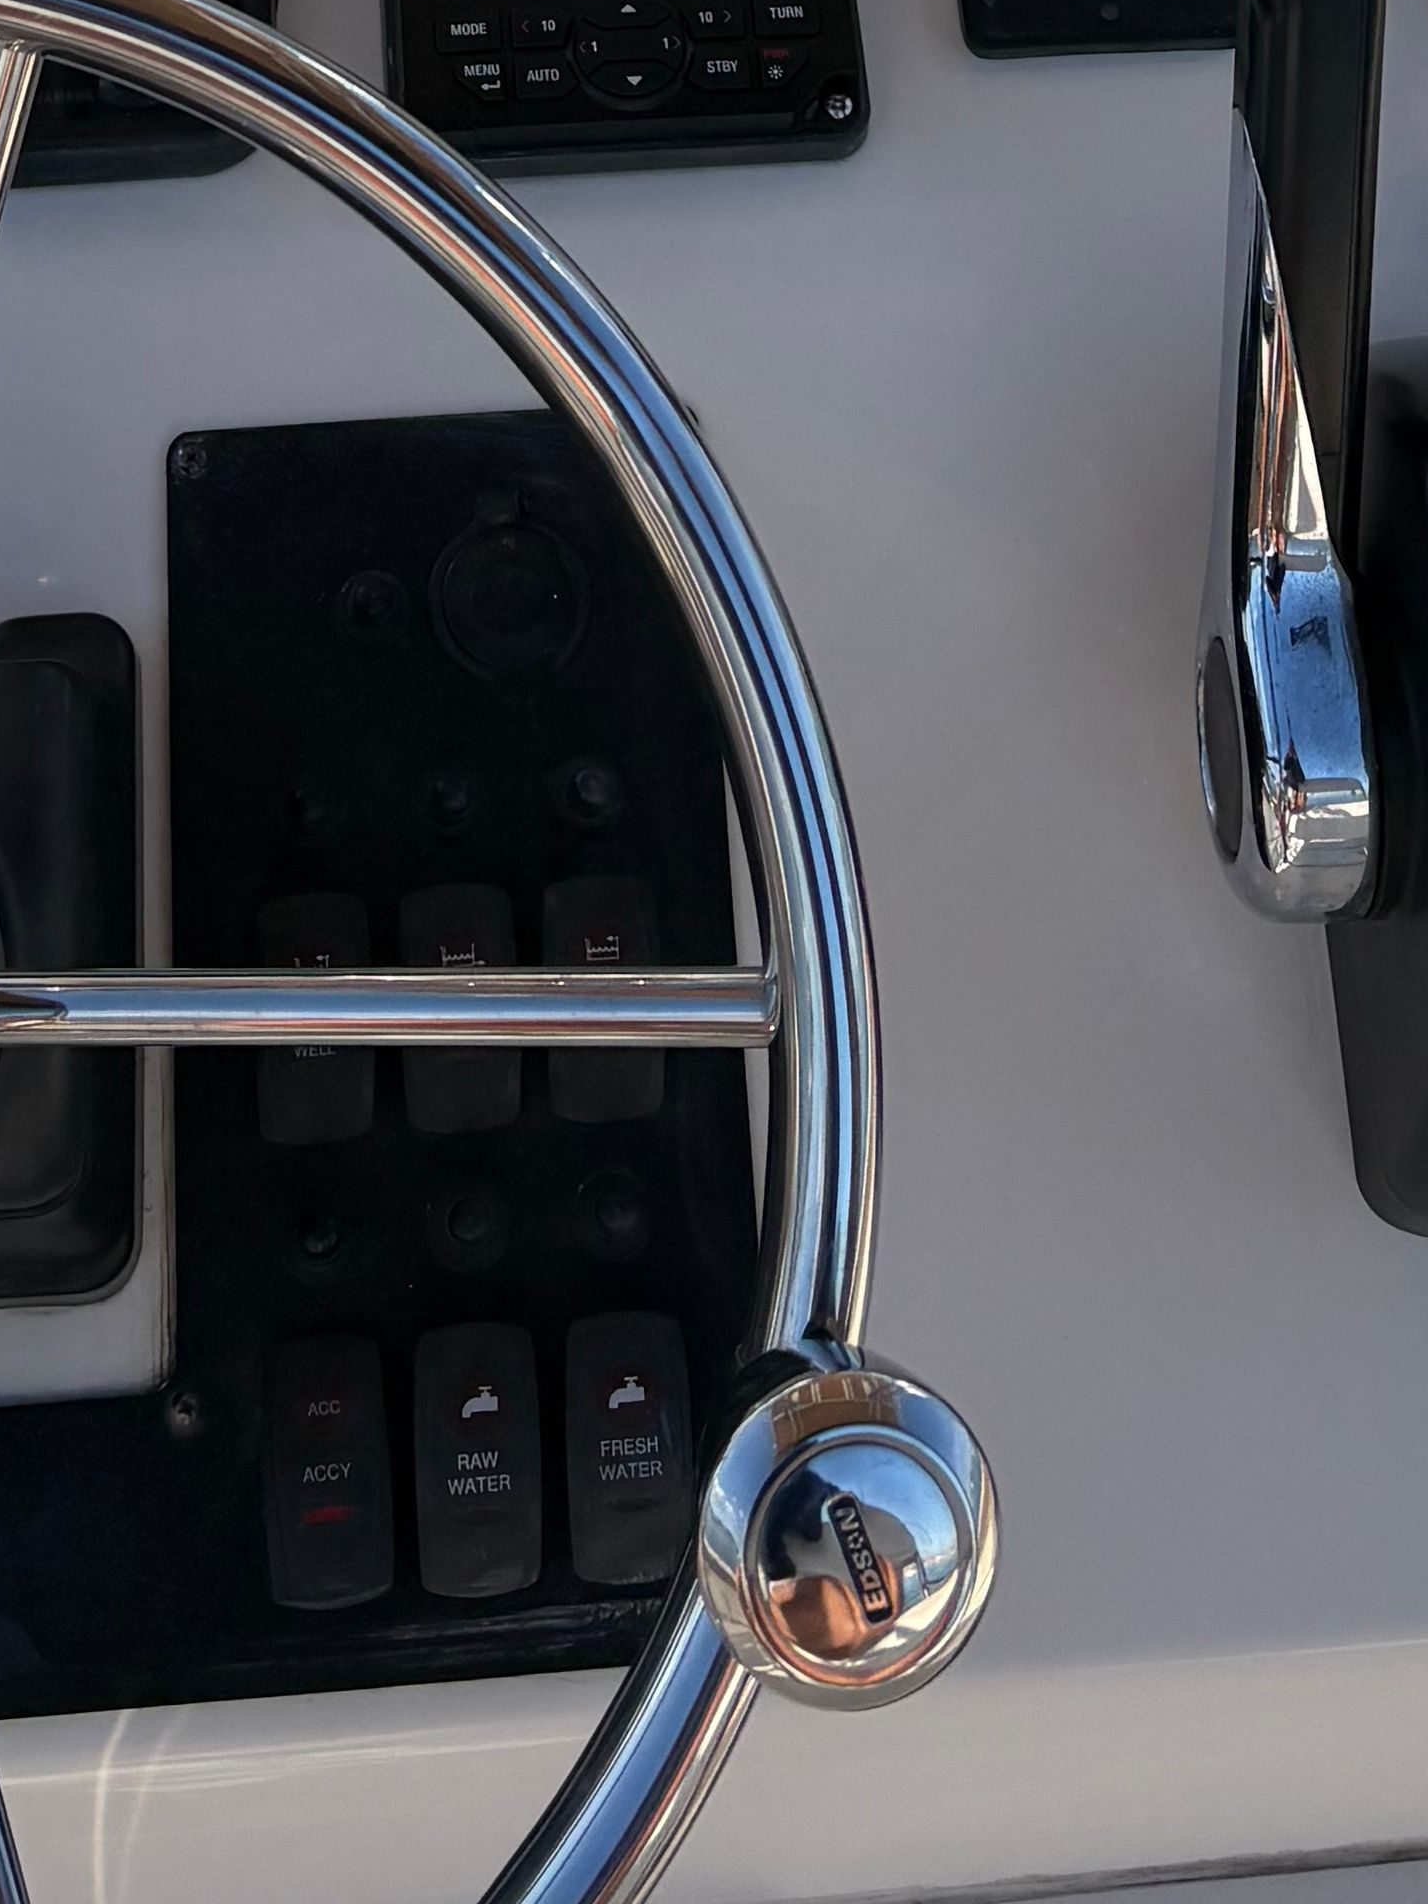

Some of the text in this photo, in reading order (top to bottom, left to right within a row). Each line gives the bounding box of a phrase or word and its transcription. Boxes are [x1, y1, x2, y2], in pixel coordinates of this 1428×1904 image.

[697, 10, 714, 25] 10
[768, 5, 805, 20] TURN
[450, 21, 490, 36] MODE
[540, 18, 557, 33] 10
[463, 62, 501, 78] MENU
[705, 59, 739, 74] STBY
[526, 68, 561, 83] AUTO
[307, 1399, 341, 1417] ACC
[600, 1435, 659, 1457] FRESH
[457, 1450, 500, 1472] RAW
[302, 1462, 352, 1484] ACCY
[598, 1460, 664, 1481] WATER
[447, 1474, 512, 1496] WATER
